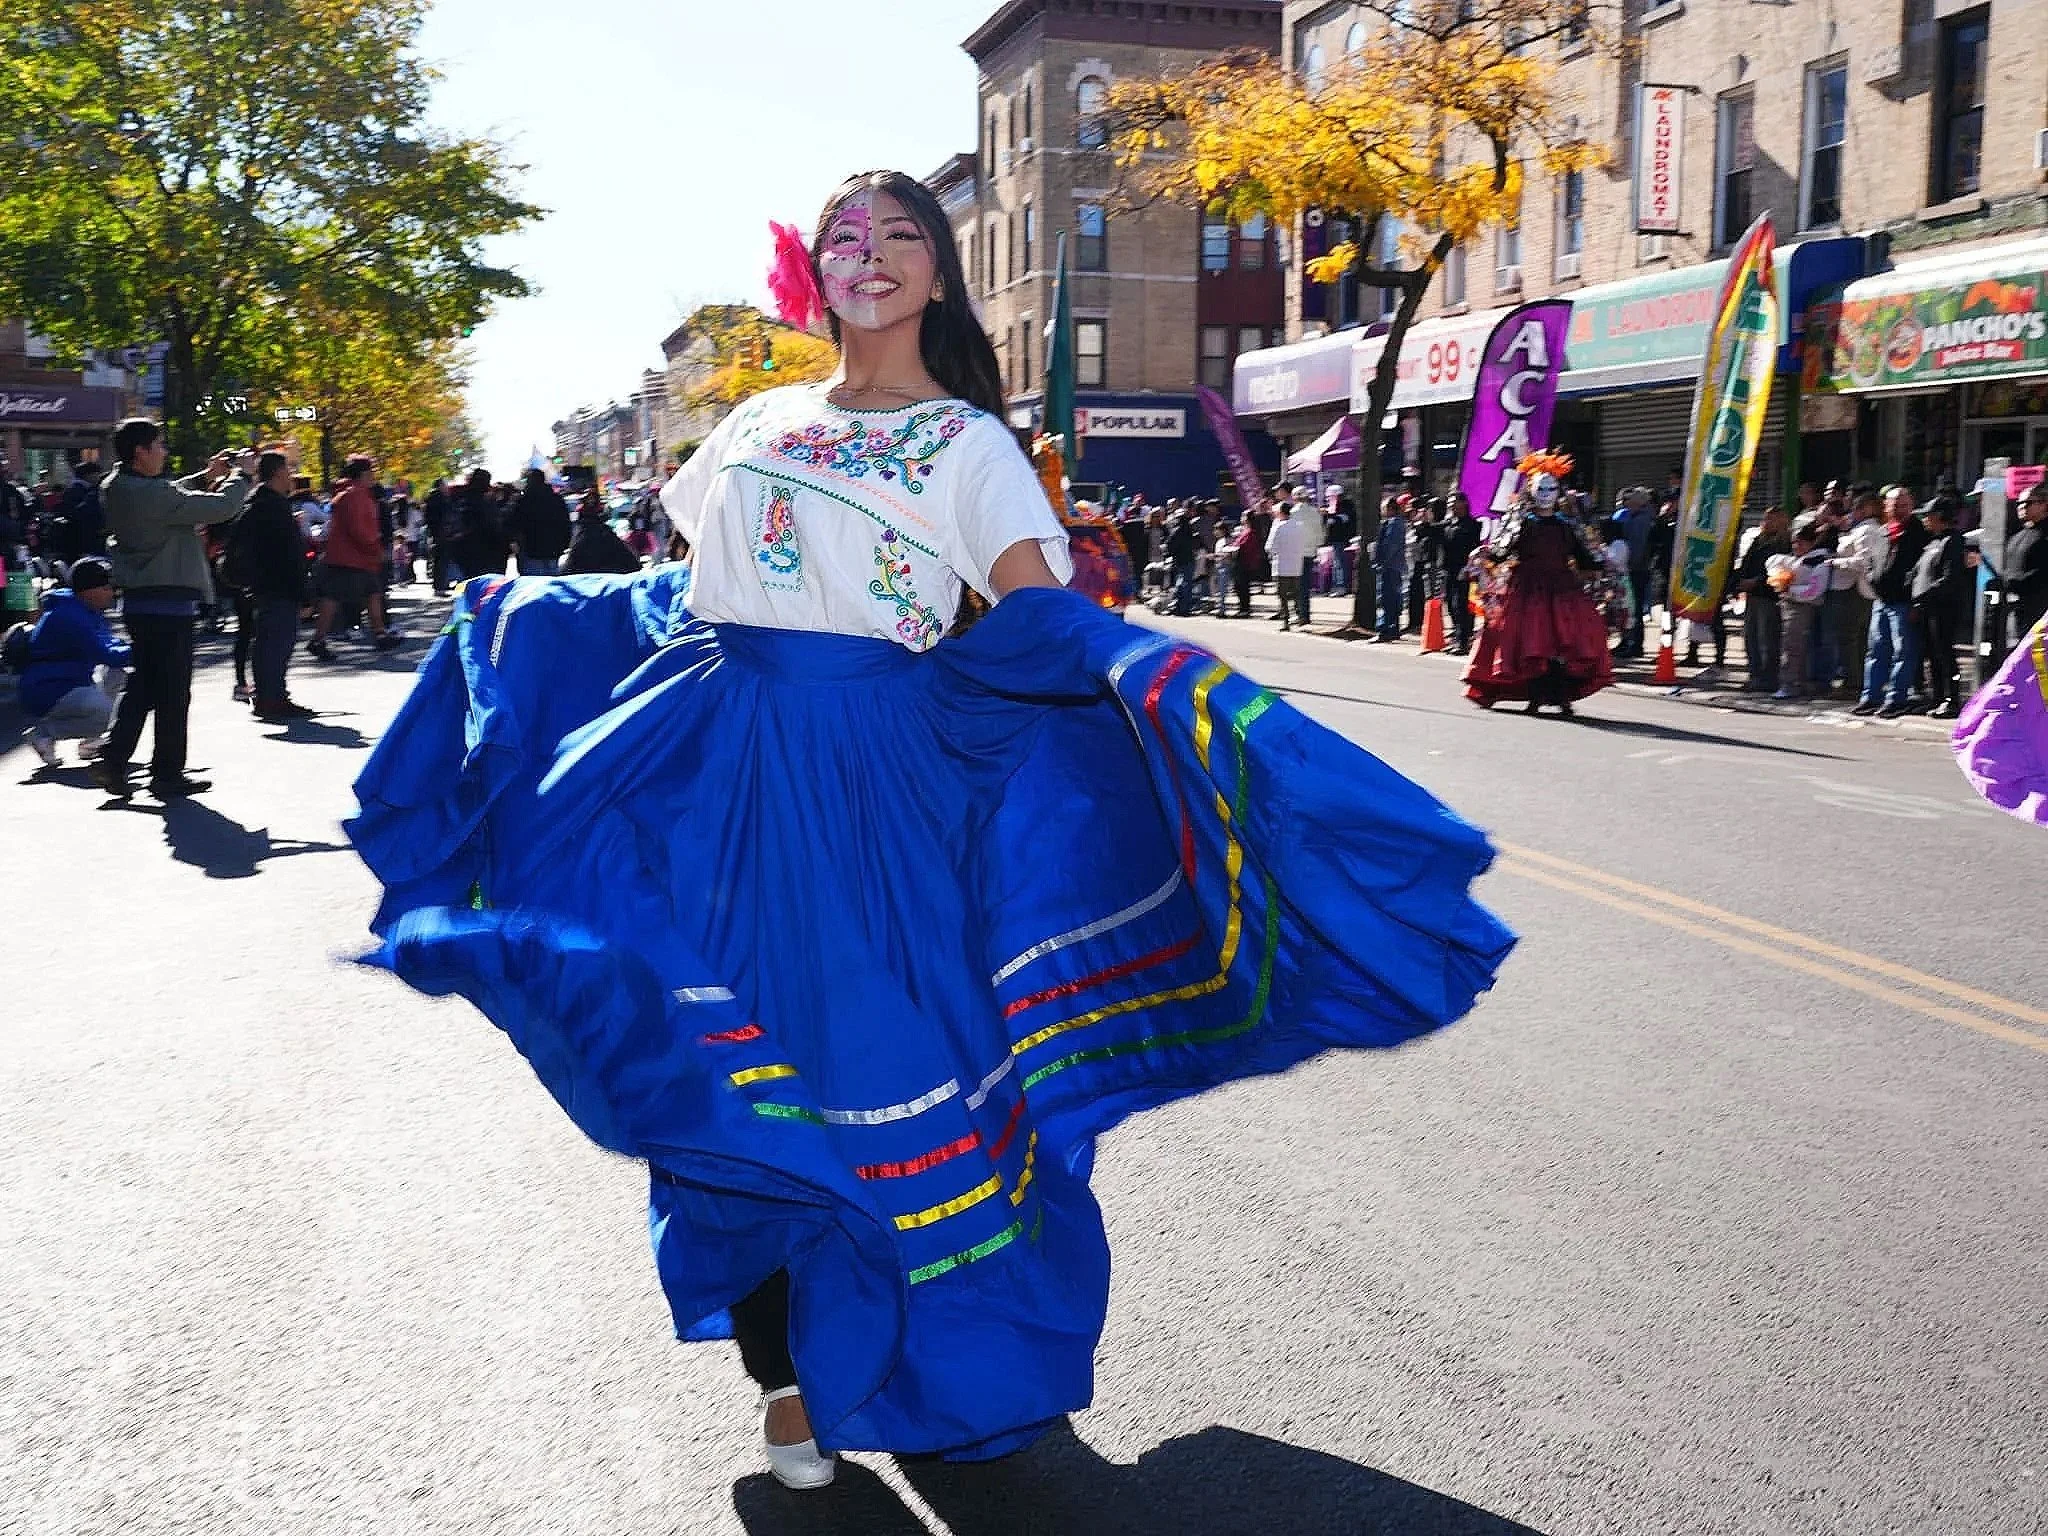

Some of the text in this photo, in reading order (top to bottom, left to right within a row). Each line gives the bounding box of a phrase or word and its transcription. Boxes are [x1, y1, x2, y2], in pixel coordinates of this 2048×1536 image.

[1652, 103, 1672, 217] LAUNDROMAT
[1608, 287, 1715, 339] LAUNDROM
[1923, 311, 2046, 352] PANCHO'S
[1091, 415, 1177, 429] POPULAR
